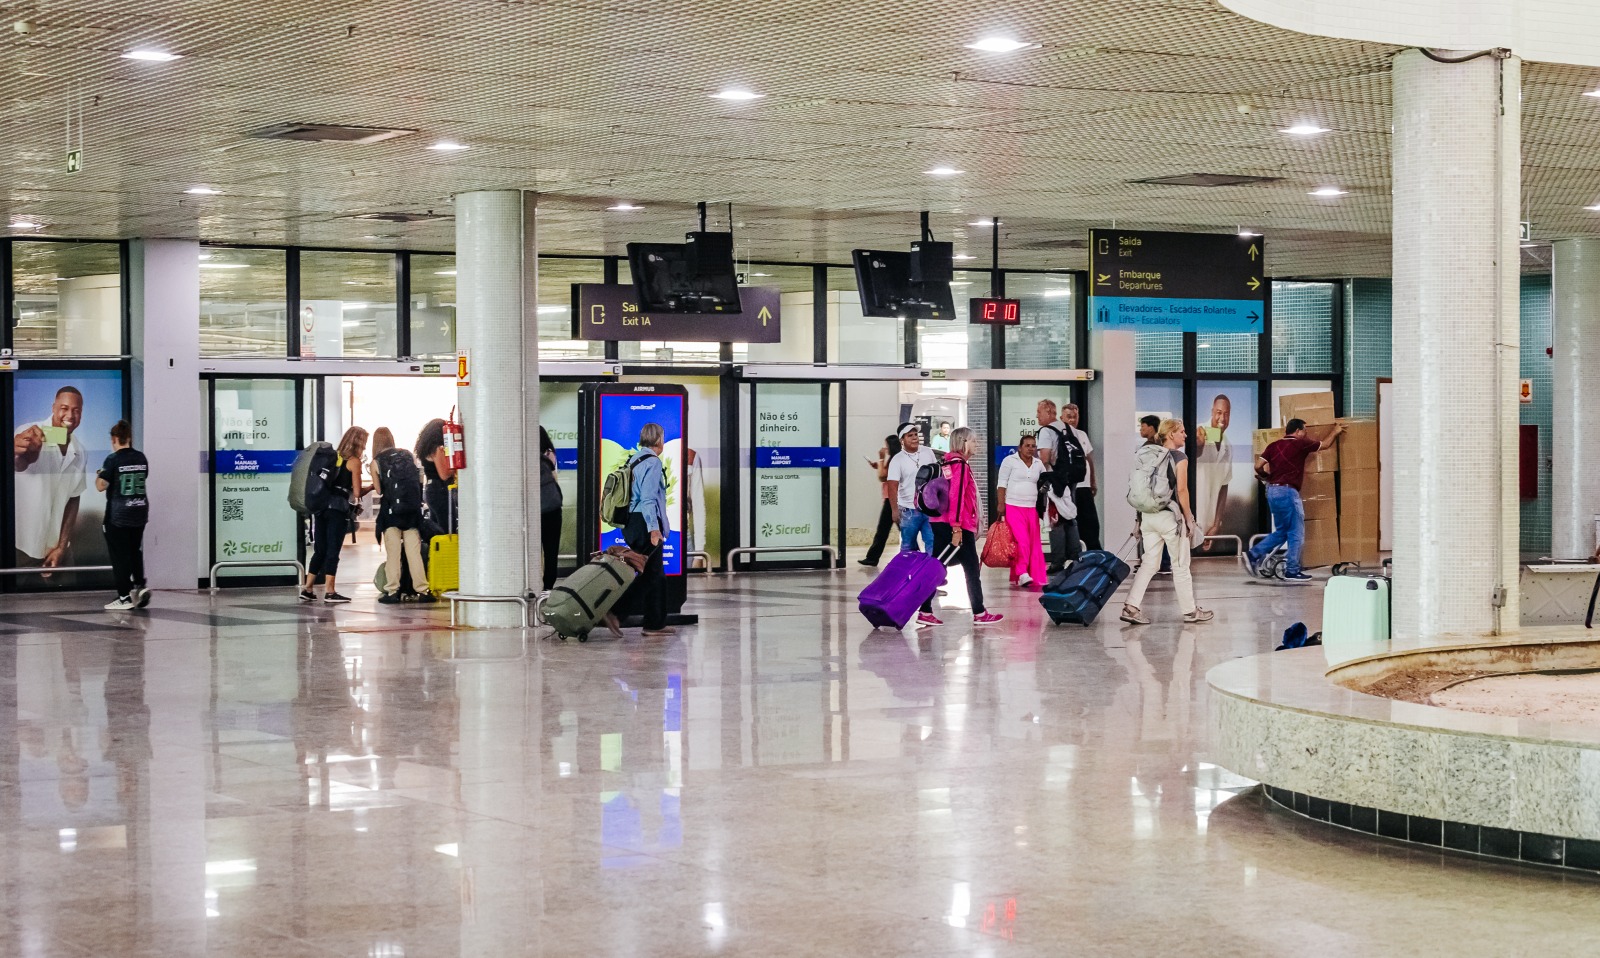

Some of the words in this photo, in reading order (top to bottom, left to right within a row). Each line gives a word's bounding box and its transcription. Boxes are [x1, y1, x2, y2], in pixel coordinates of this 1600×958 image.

[1119, 248, 1132, 257] Exit
[1119, 269, 1161, 281] Embarque
[1119, 280, 1163, 291] Departures
[1119, 304, 1162, 313] Elevadores
[1169, 305, 1201, 314] Escadas
[1203, 306, 1237, 315] Rolantes
[622, 316, 639, 326] Exit
[641, 316, 651, 326] 1A
[1119, 315, 1134, 325] Lifts
[1141, 316, 1181, 325] Escalators
[255, 416, 268, 427] só
[760, 412, 777, 421] Não
[780, 413, 785, 421] é
[787, 412, 798, 421] só
[1020, 417, 1036, 426] Não
[760, 423, 800, 432] dinheiro.
[775, 523, 810, 535] Sicredi
[240, 541, 283, 554] Sicredi
